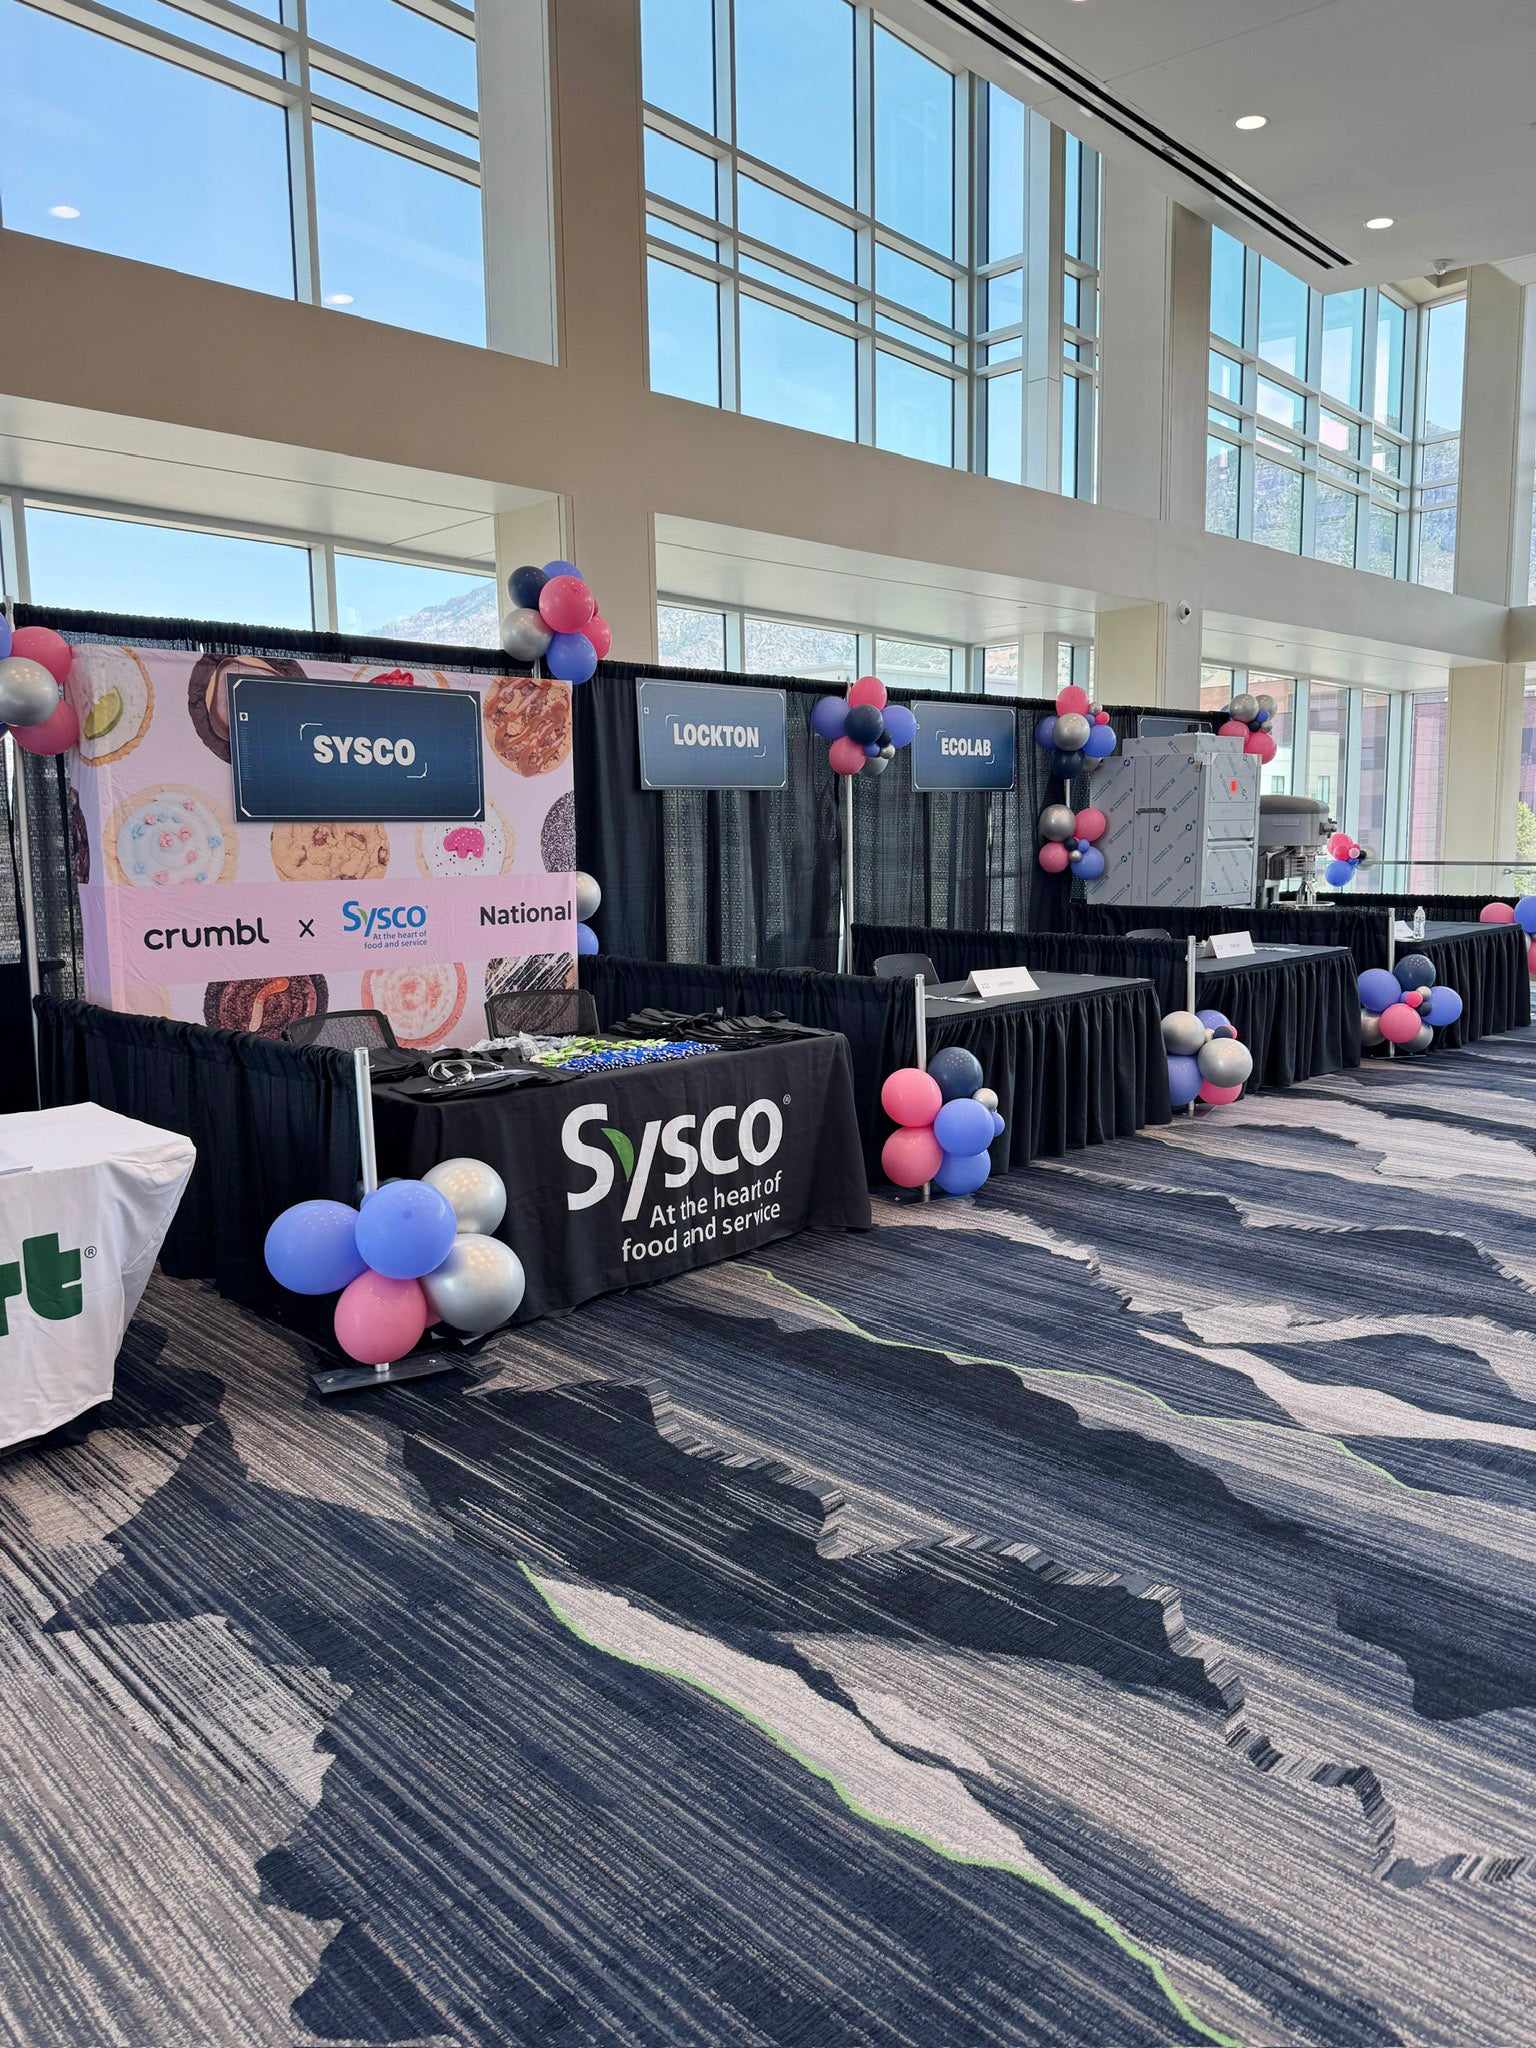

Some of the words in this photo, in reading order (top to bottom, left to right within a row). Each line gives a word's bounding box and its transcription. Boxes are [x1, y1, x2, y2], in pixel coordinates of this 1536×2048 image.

[313, 735, 416, 766] SYSCO
[673, 722, 760, 748] LOCKTON
[941, 737, 992, 757] ECOLAB
[143, 917, 270, 950] crumbl
[342, 900, 426, 937] Sysco
[480, 901, 572, 926] National
[384, 940, 400, 948] and
[401, 939, 428, 947] service
[561, 1098, 783, 1222] Sysco
[650, 1205, 676, 1228] At
[680, 1196, 708, 1221] the
[714, 1183, 762, 1210] heart
[764, 1170, 783, 1195] of
[622, 1228, 678, 1262] food
[683, 1216, 716, 1248] and
[722, 1202, 781, 1235] service
